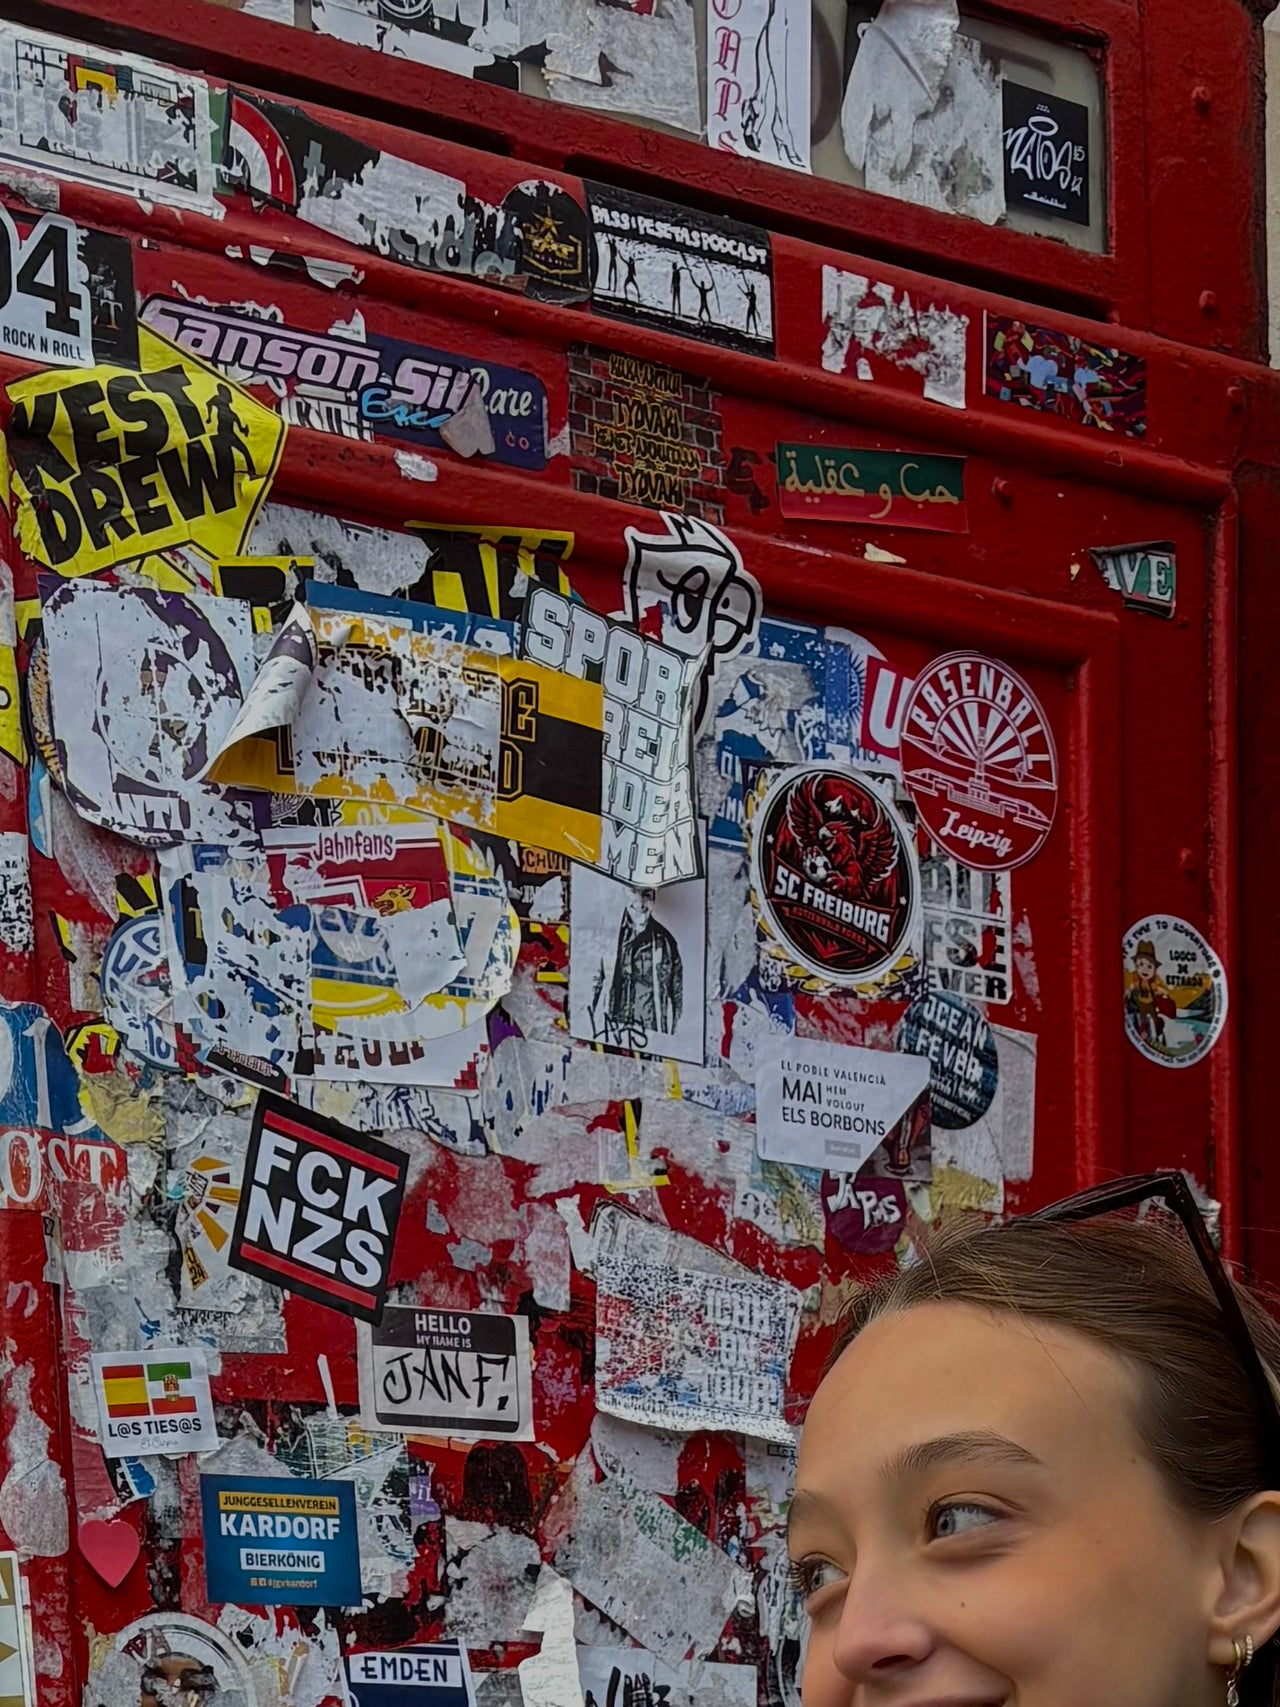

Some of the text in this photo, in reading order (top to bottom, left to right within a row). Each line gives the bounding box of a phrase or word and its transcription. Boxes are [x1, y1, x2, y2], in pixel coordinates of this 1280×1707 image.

[3, 325, 37, 350] ROCK
[40, 335, 50, 354] N
[53, 339, 86, 362] ROLL
[11, 365, 208, 482] KEST
[33, 430, 239, 565] DREW
[911, 656, 1039, 771] RASENBALL
[313, 830, 396, 862] Jahnfans
[936, 806, 1015, 858] Leipzig
[773, 864, 892, 944] SC FREIBURG
[781, 1078, 848, 1106] MAI HEM
[781, 1105, 887, 1138] ELS BORBONS
[254, 1129, 399, 1237] FCK
[240, 1186, 385, 1289] NZS
[414, 1313, 472, 1336] HELLO
[415, 1336, 430, 1347] MY
[431, 1336, 460, 1348] NAME
[144, 1417, 202, 1436] TIES@S
[222, 1495, 337, 1511] JUNGGESELLENVEREIN
[220, 1512, 341, 1541] KARDORF
[245, 1551, 321, 1569] BIERKÖNIG
[360, 1655, 453, 1686] EMDEN
